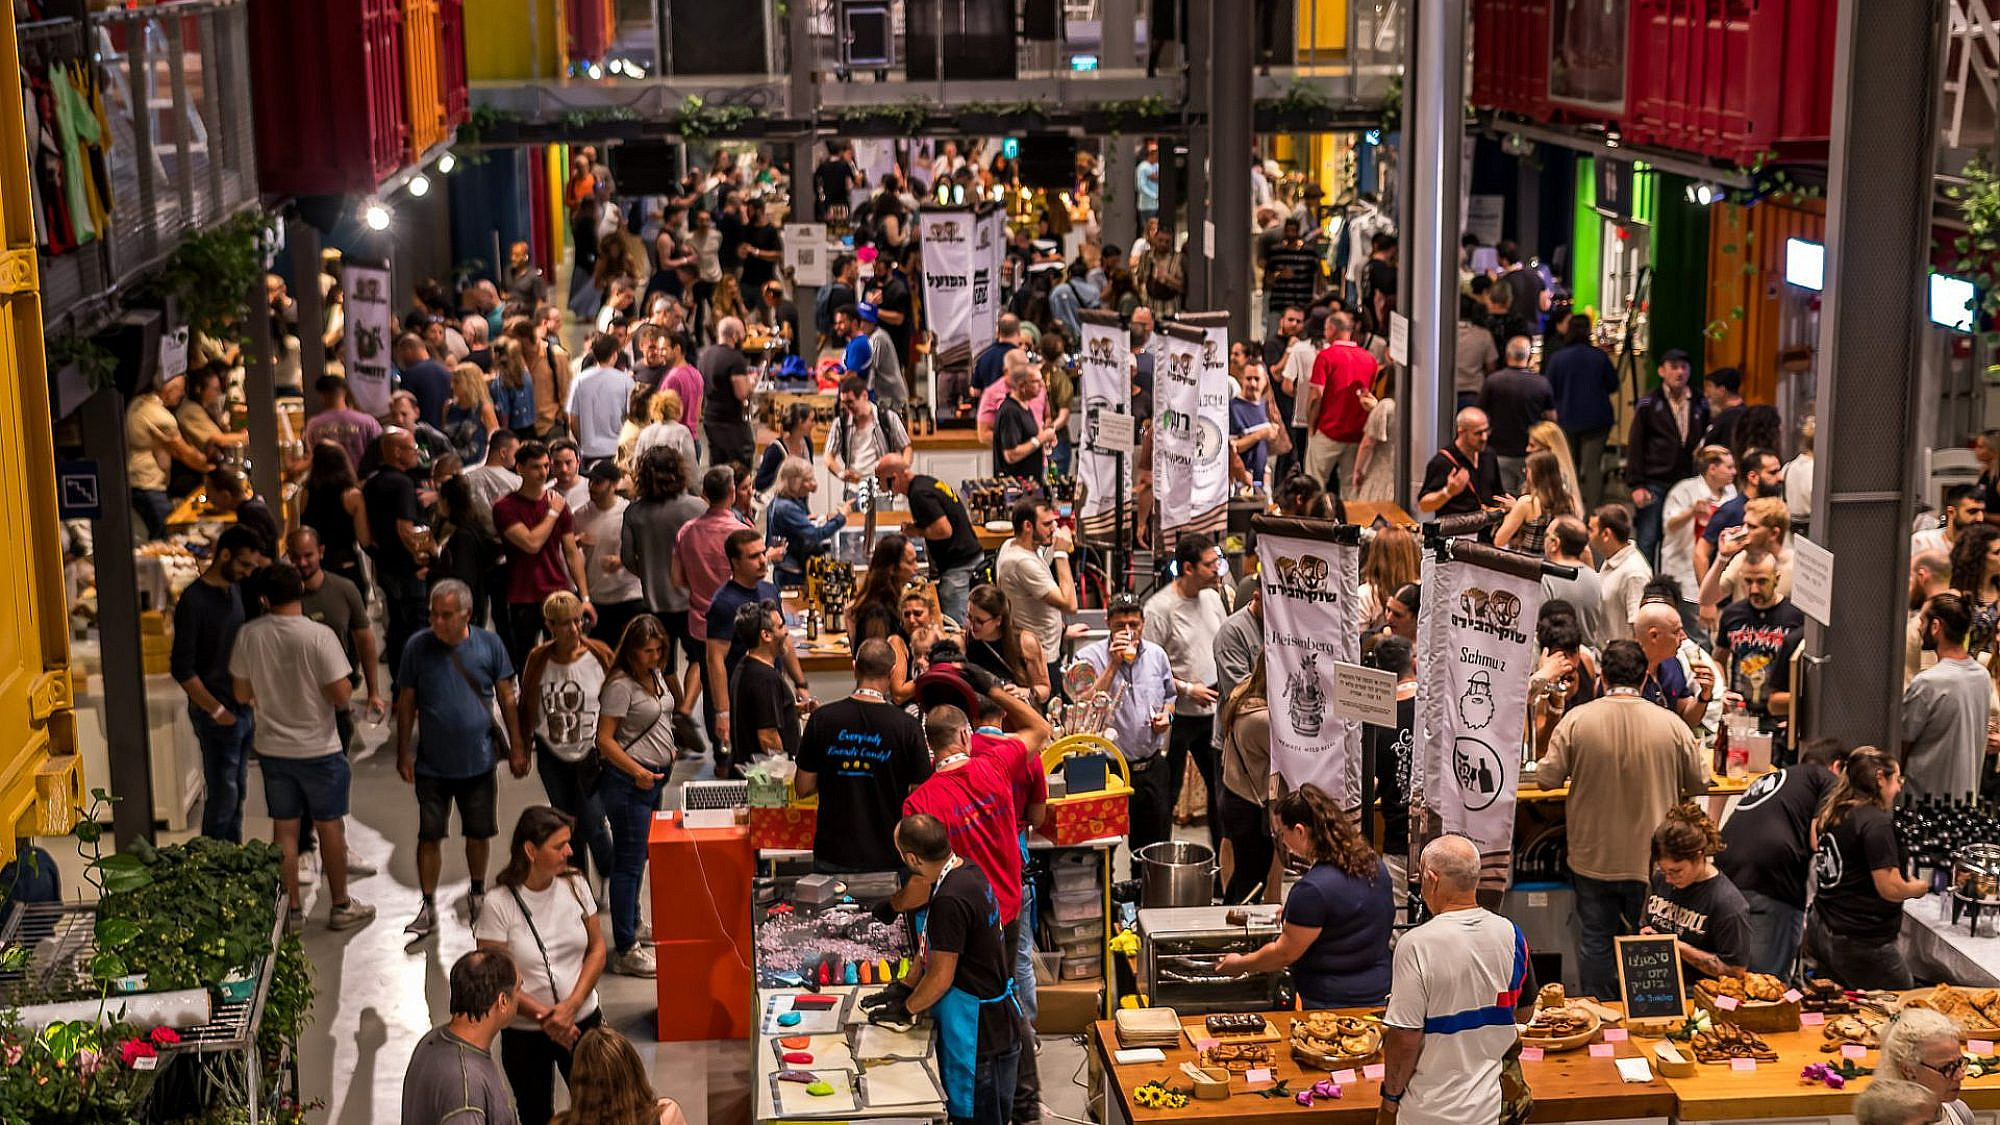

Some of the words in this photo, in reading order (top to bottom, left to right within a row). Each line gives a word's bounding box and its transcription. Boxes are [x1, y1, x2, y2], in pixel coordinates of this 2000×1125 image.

[1266, 583, 1305, 600] הבירה
[1308, 590, 1338, 604] שוק
[1451, 612, 1495, 635] הבירה
[1497, 627, 1528, 645] שוק
